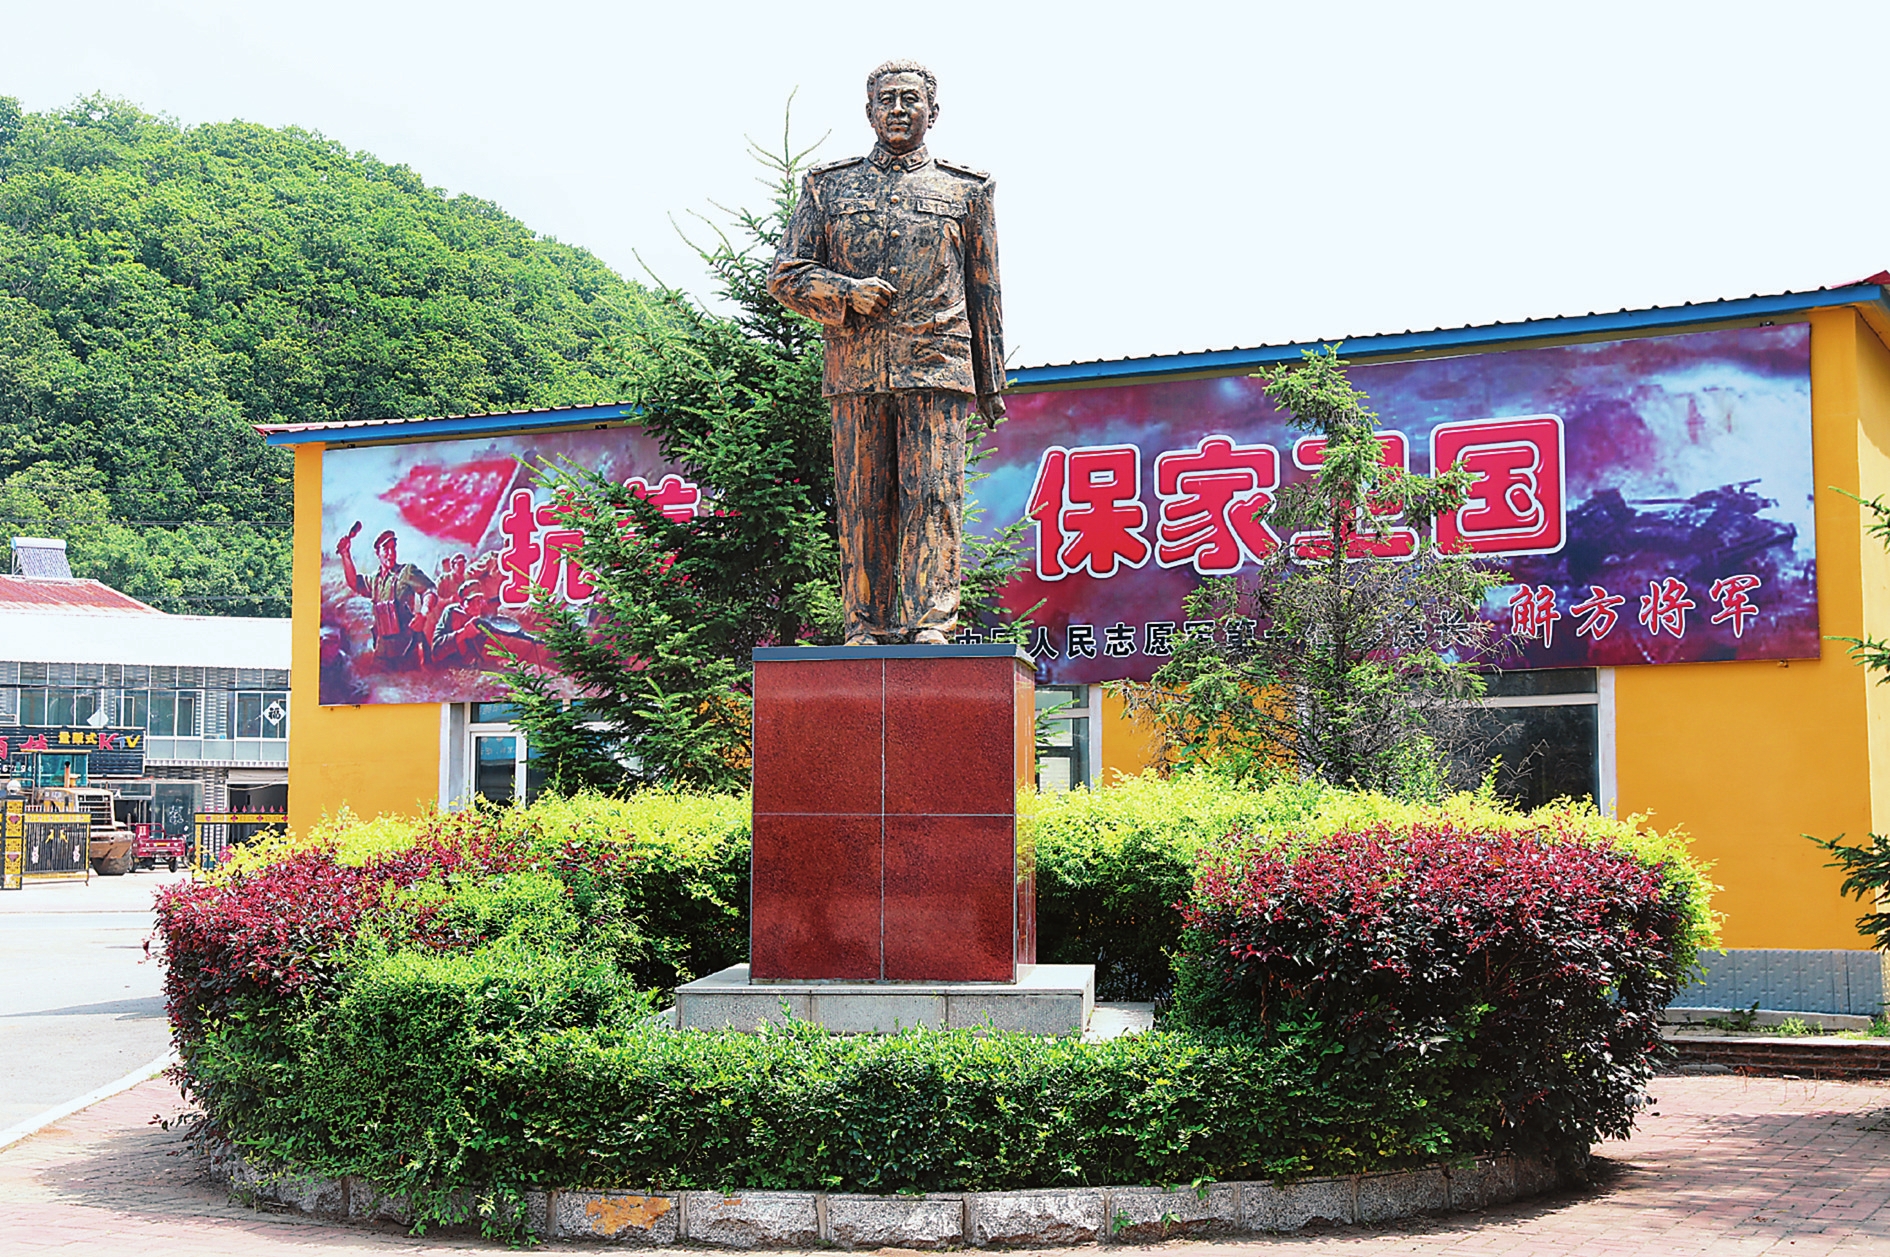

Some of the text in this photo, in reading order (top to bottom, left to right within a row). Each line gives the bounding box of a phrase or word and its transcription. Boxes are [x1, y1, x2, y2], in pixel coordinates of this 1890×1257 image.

[1026, 415, 1567, 581] 保家卫国
[1508, 574, 1761, 648] 解方将军
